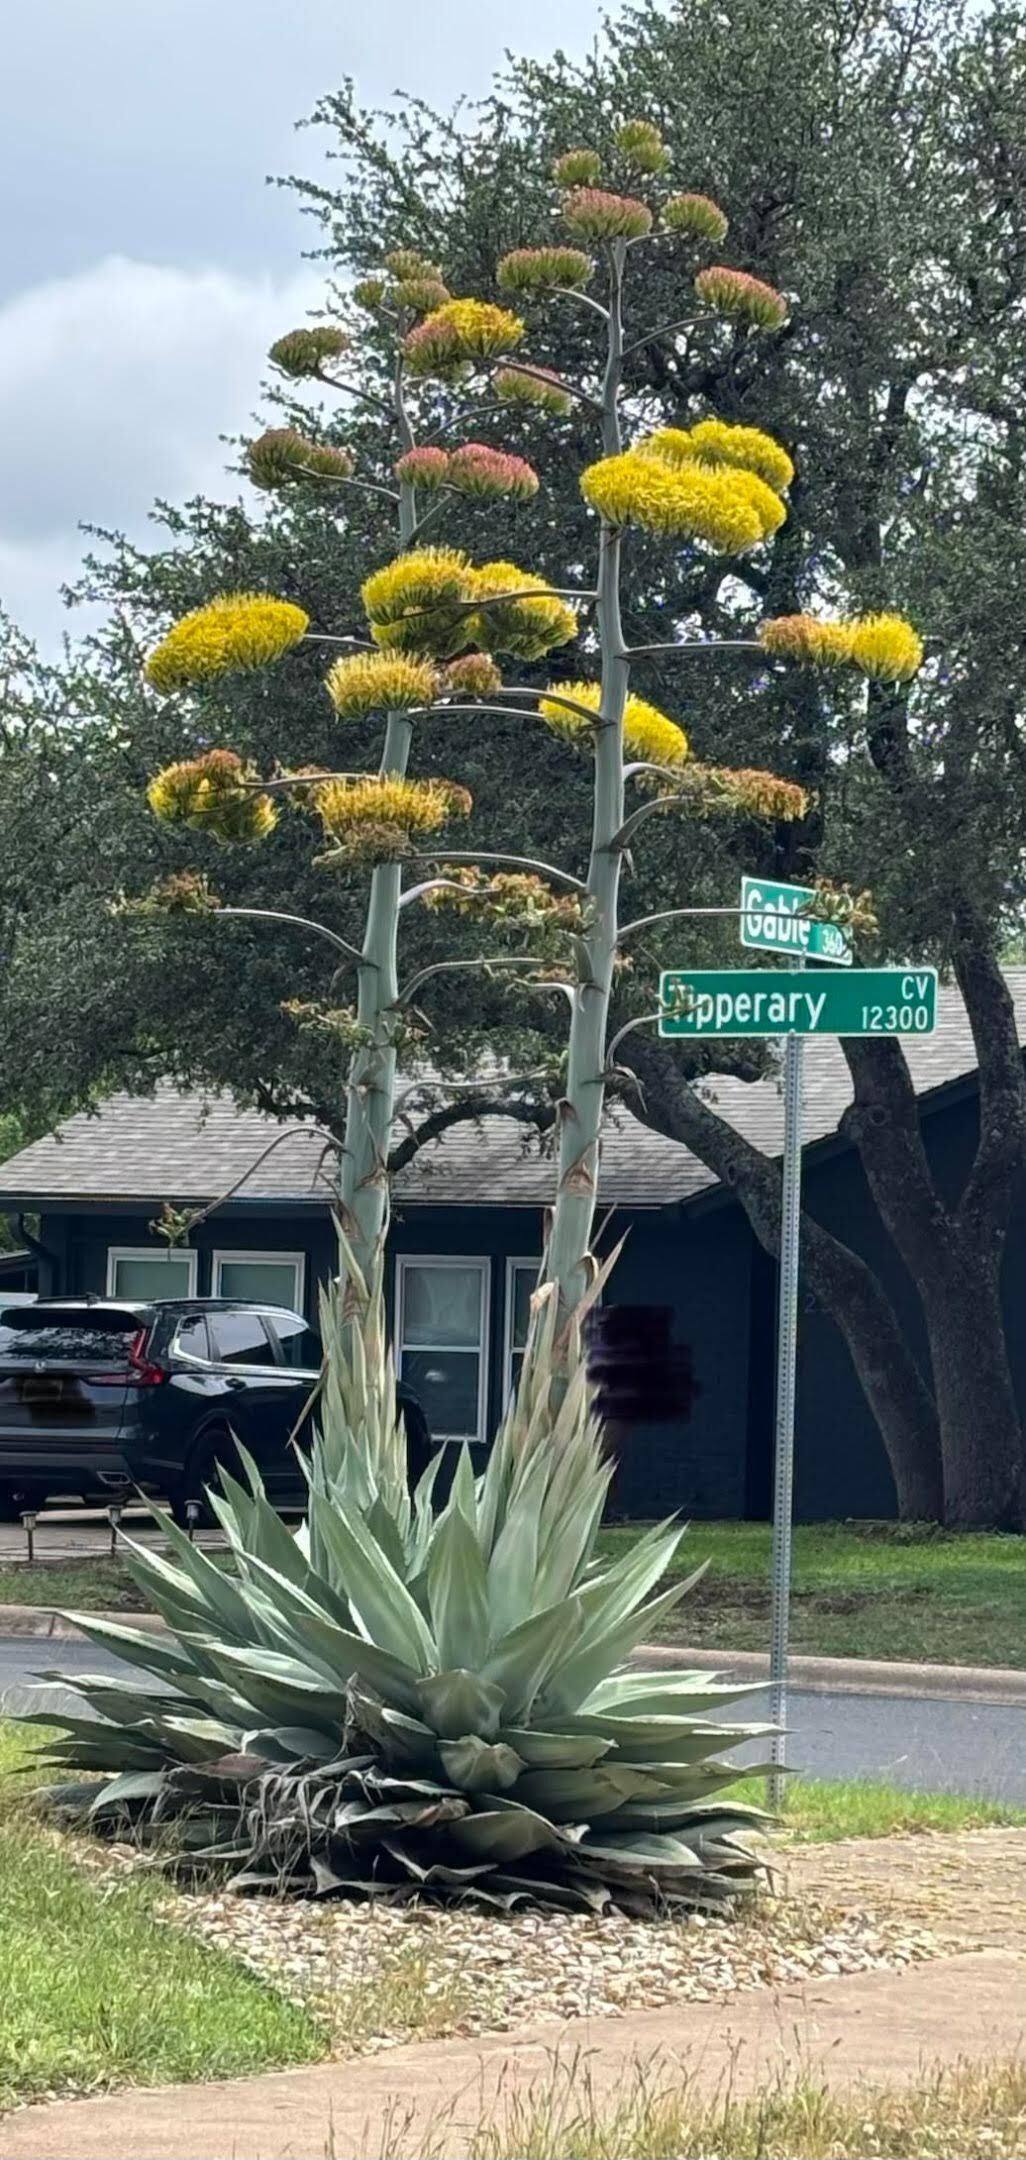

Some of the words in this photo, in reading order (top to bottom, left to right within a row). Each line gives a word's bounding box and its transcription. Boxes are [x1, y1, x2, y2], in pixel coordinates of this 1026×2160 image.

[746, 888, 811, 946] Gable
[822, 928, 848, 957] 360
[901, 975, 928, 1000] CV
[862, 1005, 928, 1030] 12300
